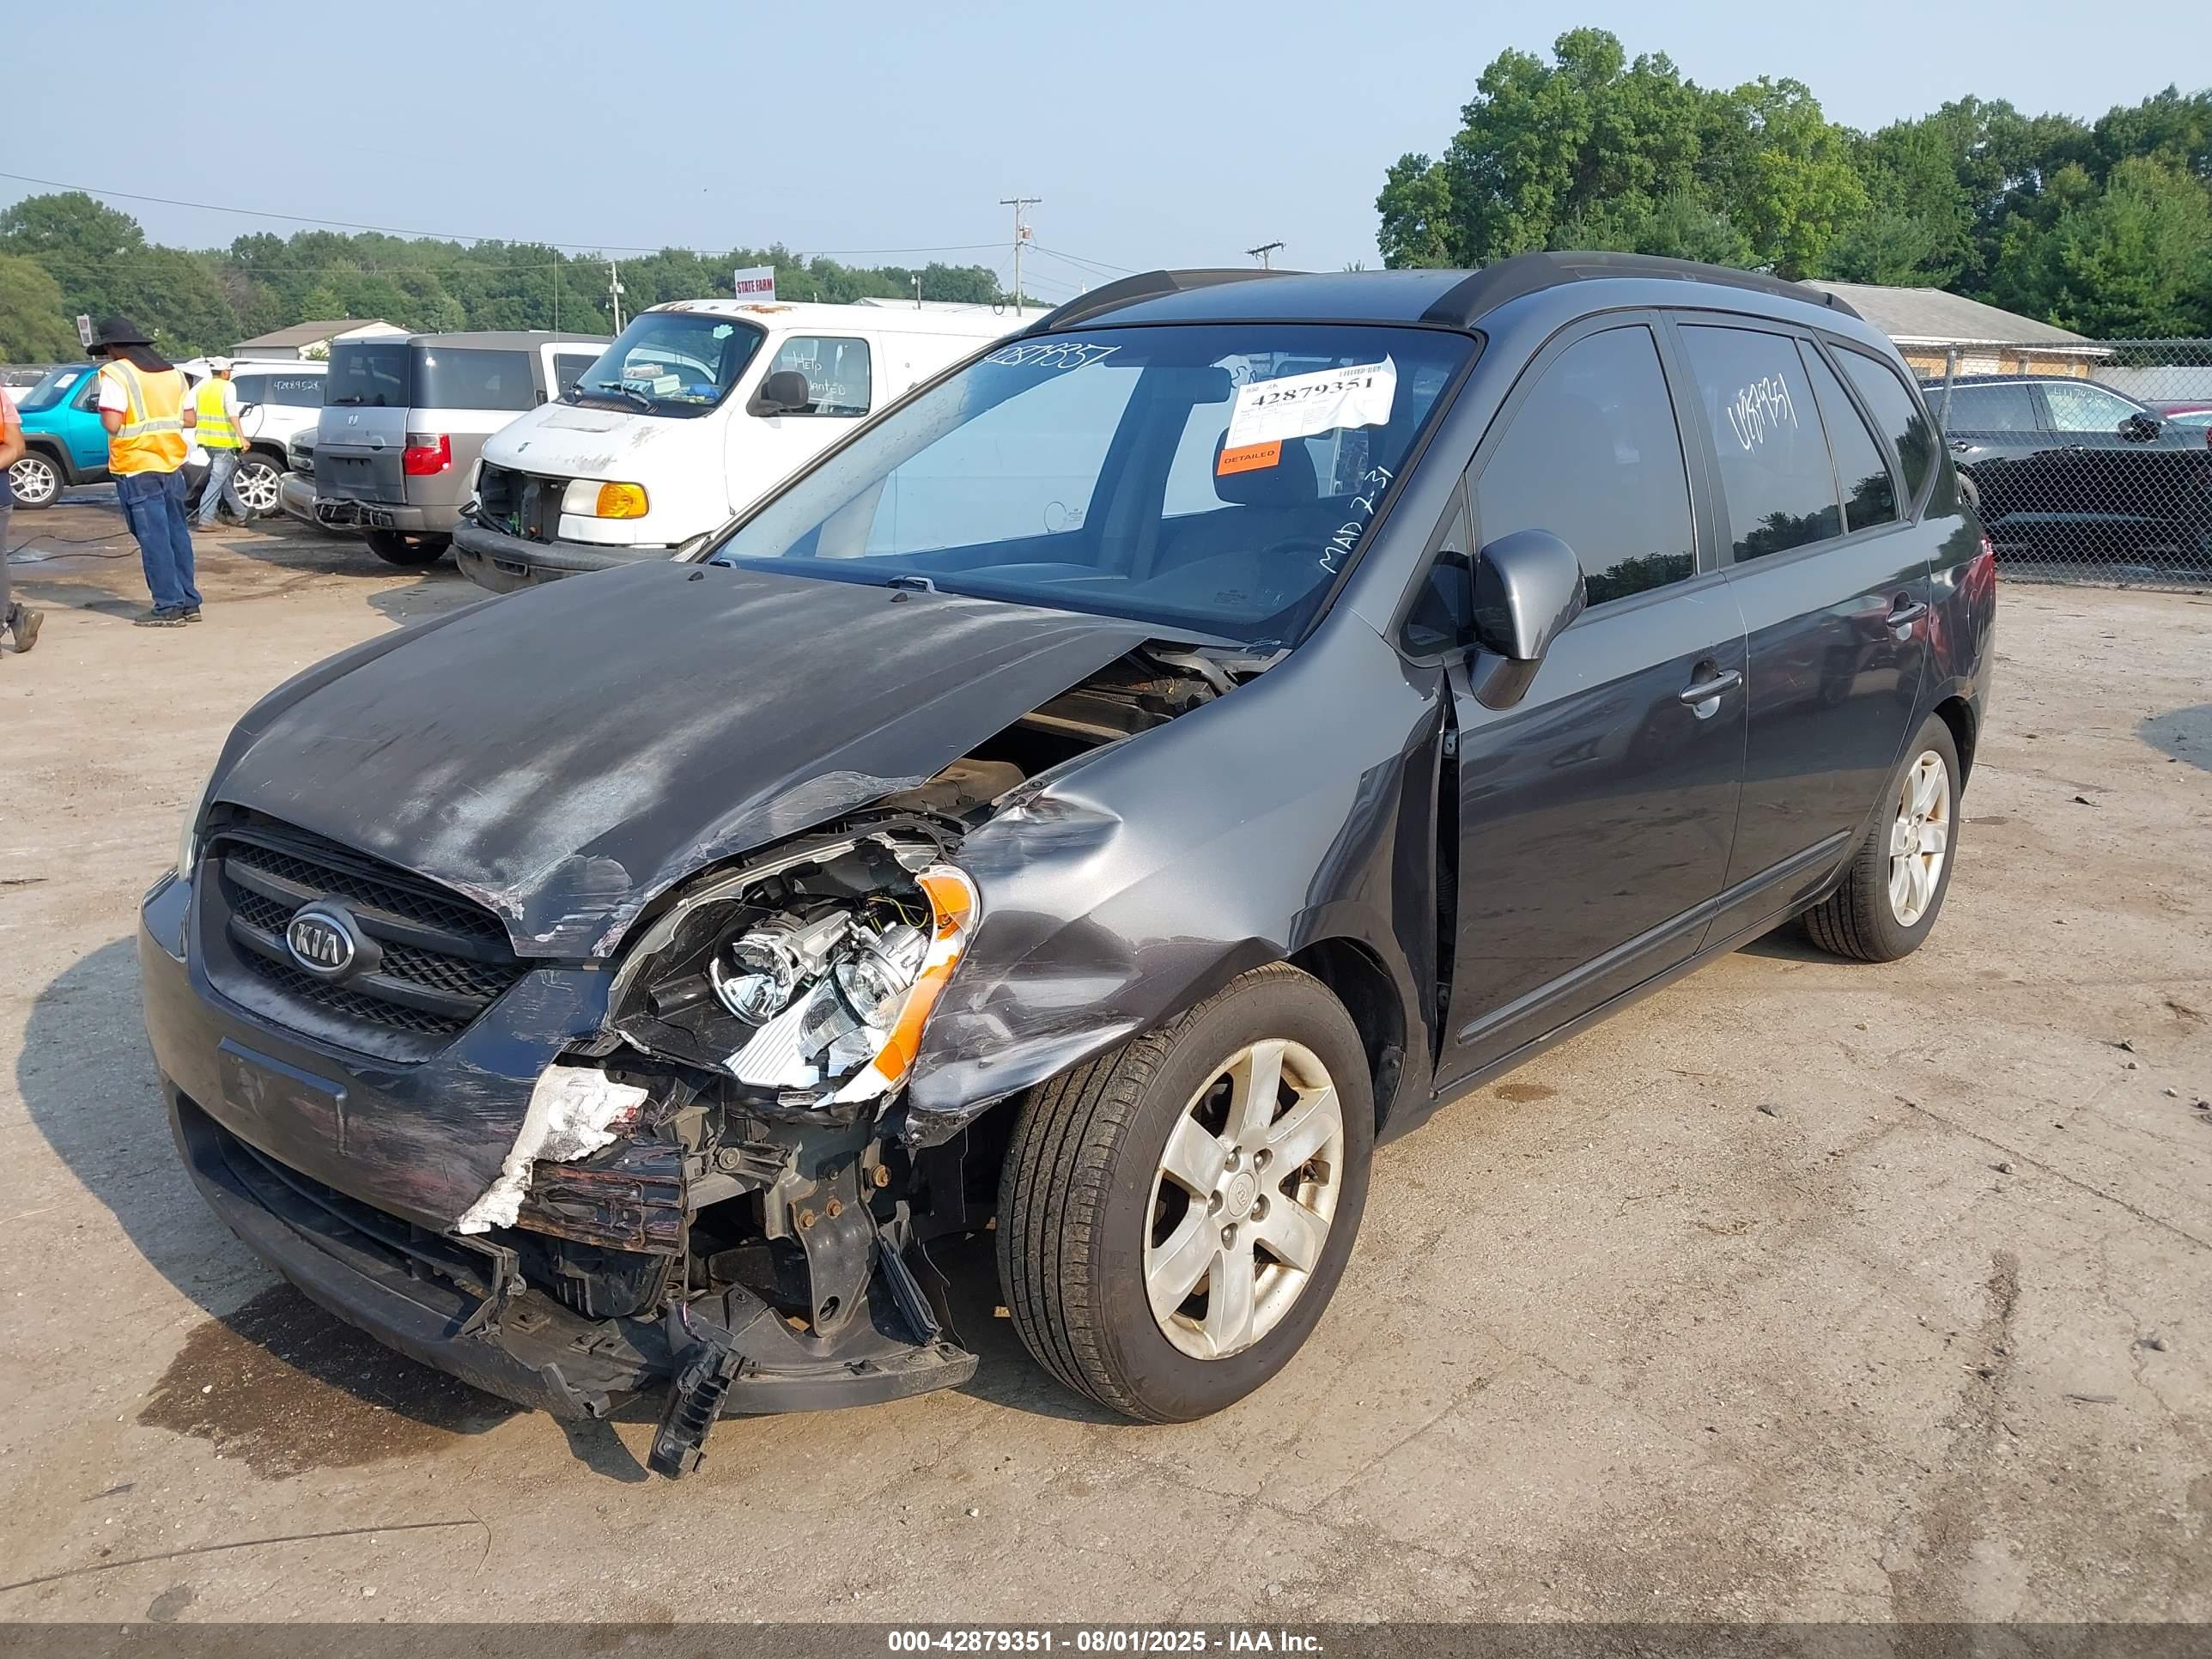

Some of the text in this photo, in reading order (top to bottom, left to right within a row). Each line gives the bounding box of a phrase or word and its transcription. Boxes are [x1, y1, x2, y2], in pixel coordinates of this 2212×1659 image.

[737, 277, 773, 294] STATE FARM
[1251, 377, 1373, 406] 42879351
[1224, 450, 1275, 464] DETAILED
[1319, 522, 1363, 574] MAD
[295, 922, 338, 964] KIA
